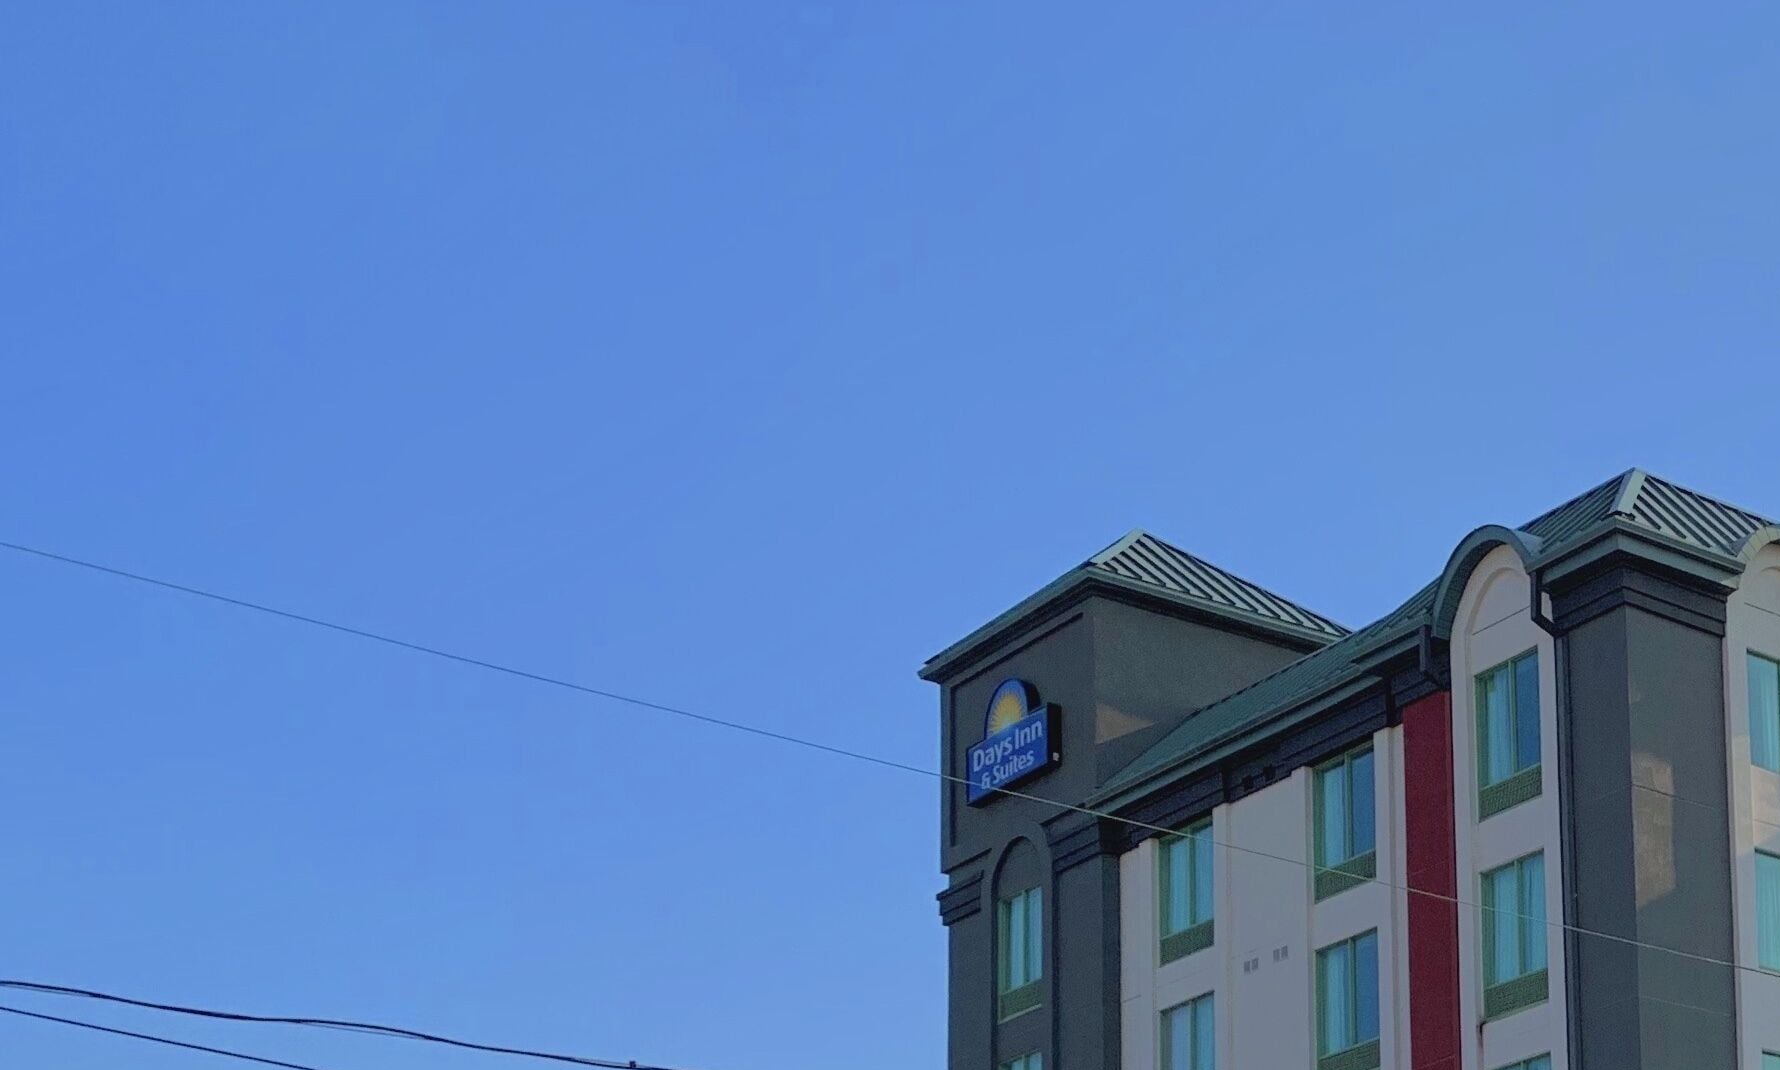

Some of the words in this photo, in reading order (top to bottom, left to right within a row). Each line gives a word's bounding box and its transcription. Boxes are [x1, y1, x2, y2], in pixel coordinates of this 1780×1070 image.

[973, 736, 1014, 772] Days
[1015, 720, 1043, 750] Inn
[981, 772, 992, 790] &
[992, 750, 1035, 784] Suites
